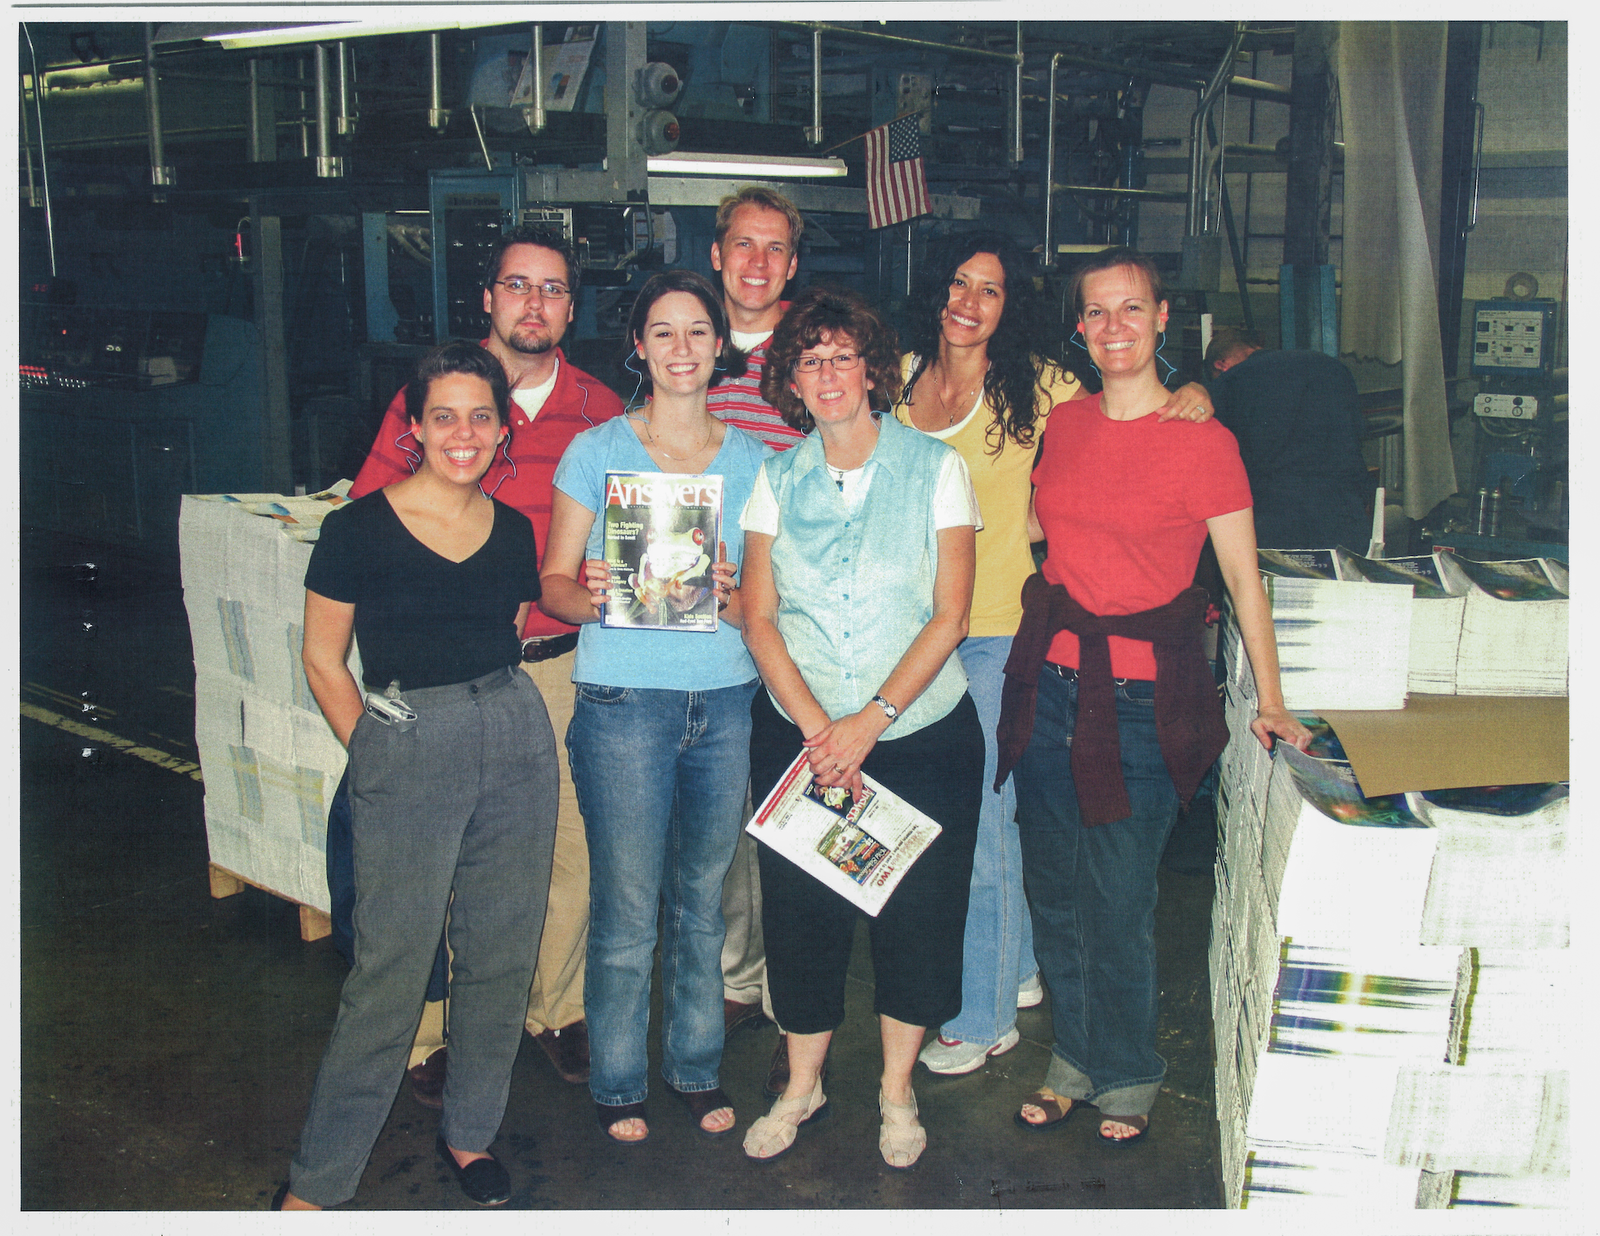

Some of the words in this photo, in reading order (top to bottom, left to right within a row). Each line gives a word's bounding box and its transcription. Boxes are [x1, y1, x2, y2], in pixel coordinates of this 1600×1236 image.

[605, 475, 719, 510] Answers
[620, 522, 643, 530] Fighting
[876, 865, 894, 887] TWO
